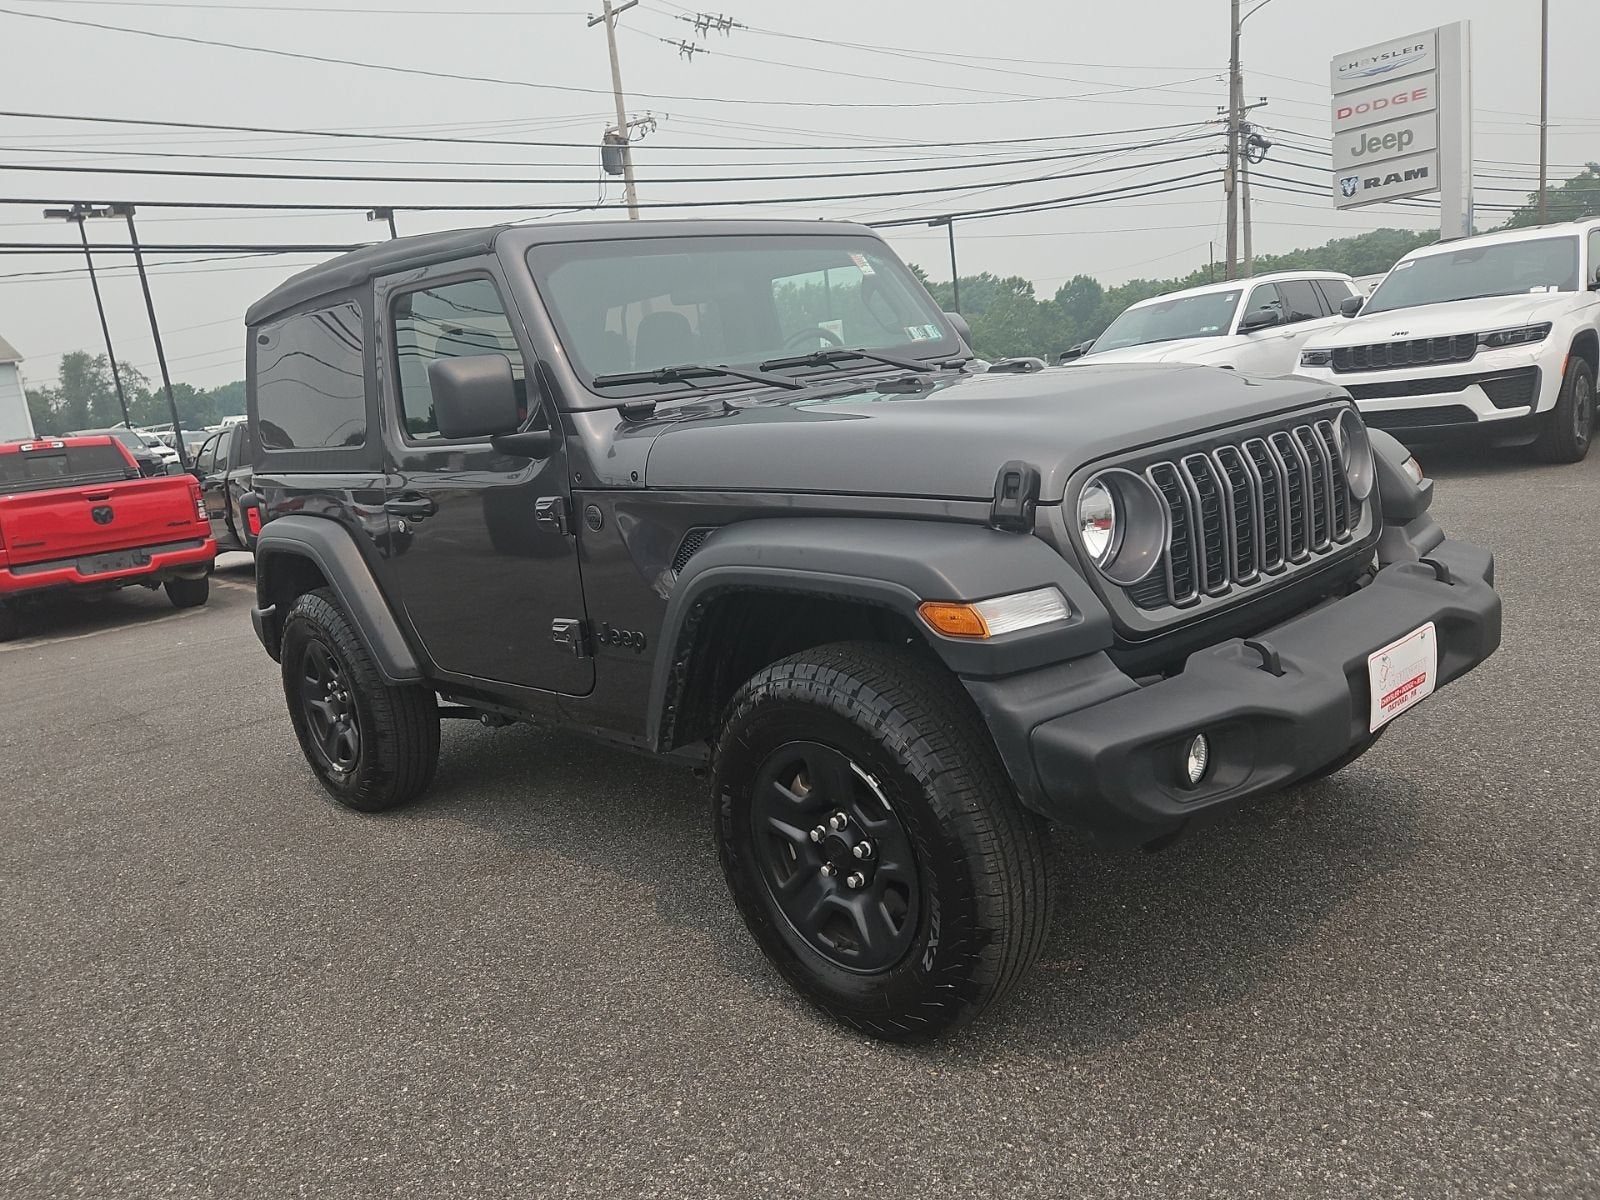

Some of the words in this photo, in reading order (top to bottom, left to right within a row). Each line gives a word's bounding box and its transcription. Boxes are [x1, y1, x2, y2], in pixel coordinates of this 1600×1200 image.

[1338, 43, 1425, 72] CHRYSLER
[1336, 87, 1428, 120] DODGE
[1350, 128, 1414, 157] Jeep
[1363, 166, 1429, 189] RAM
[596, 620, 647, 655] Jeep
